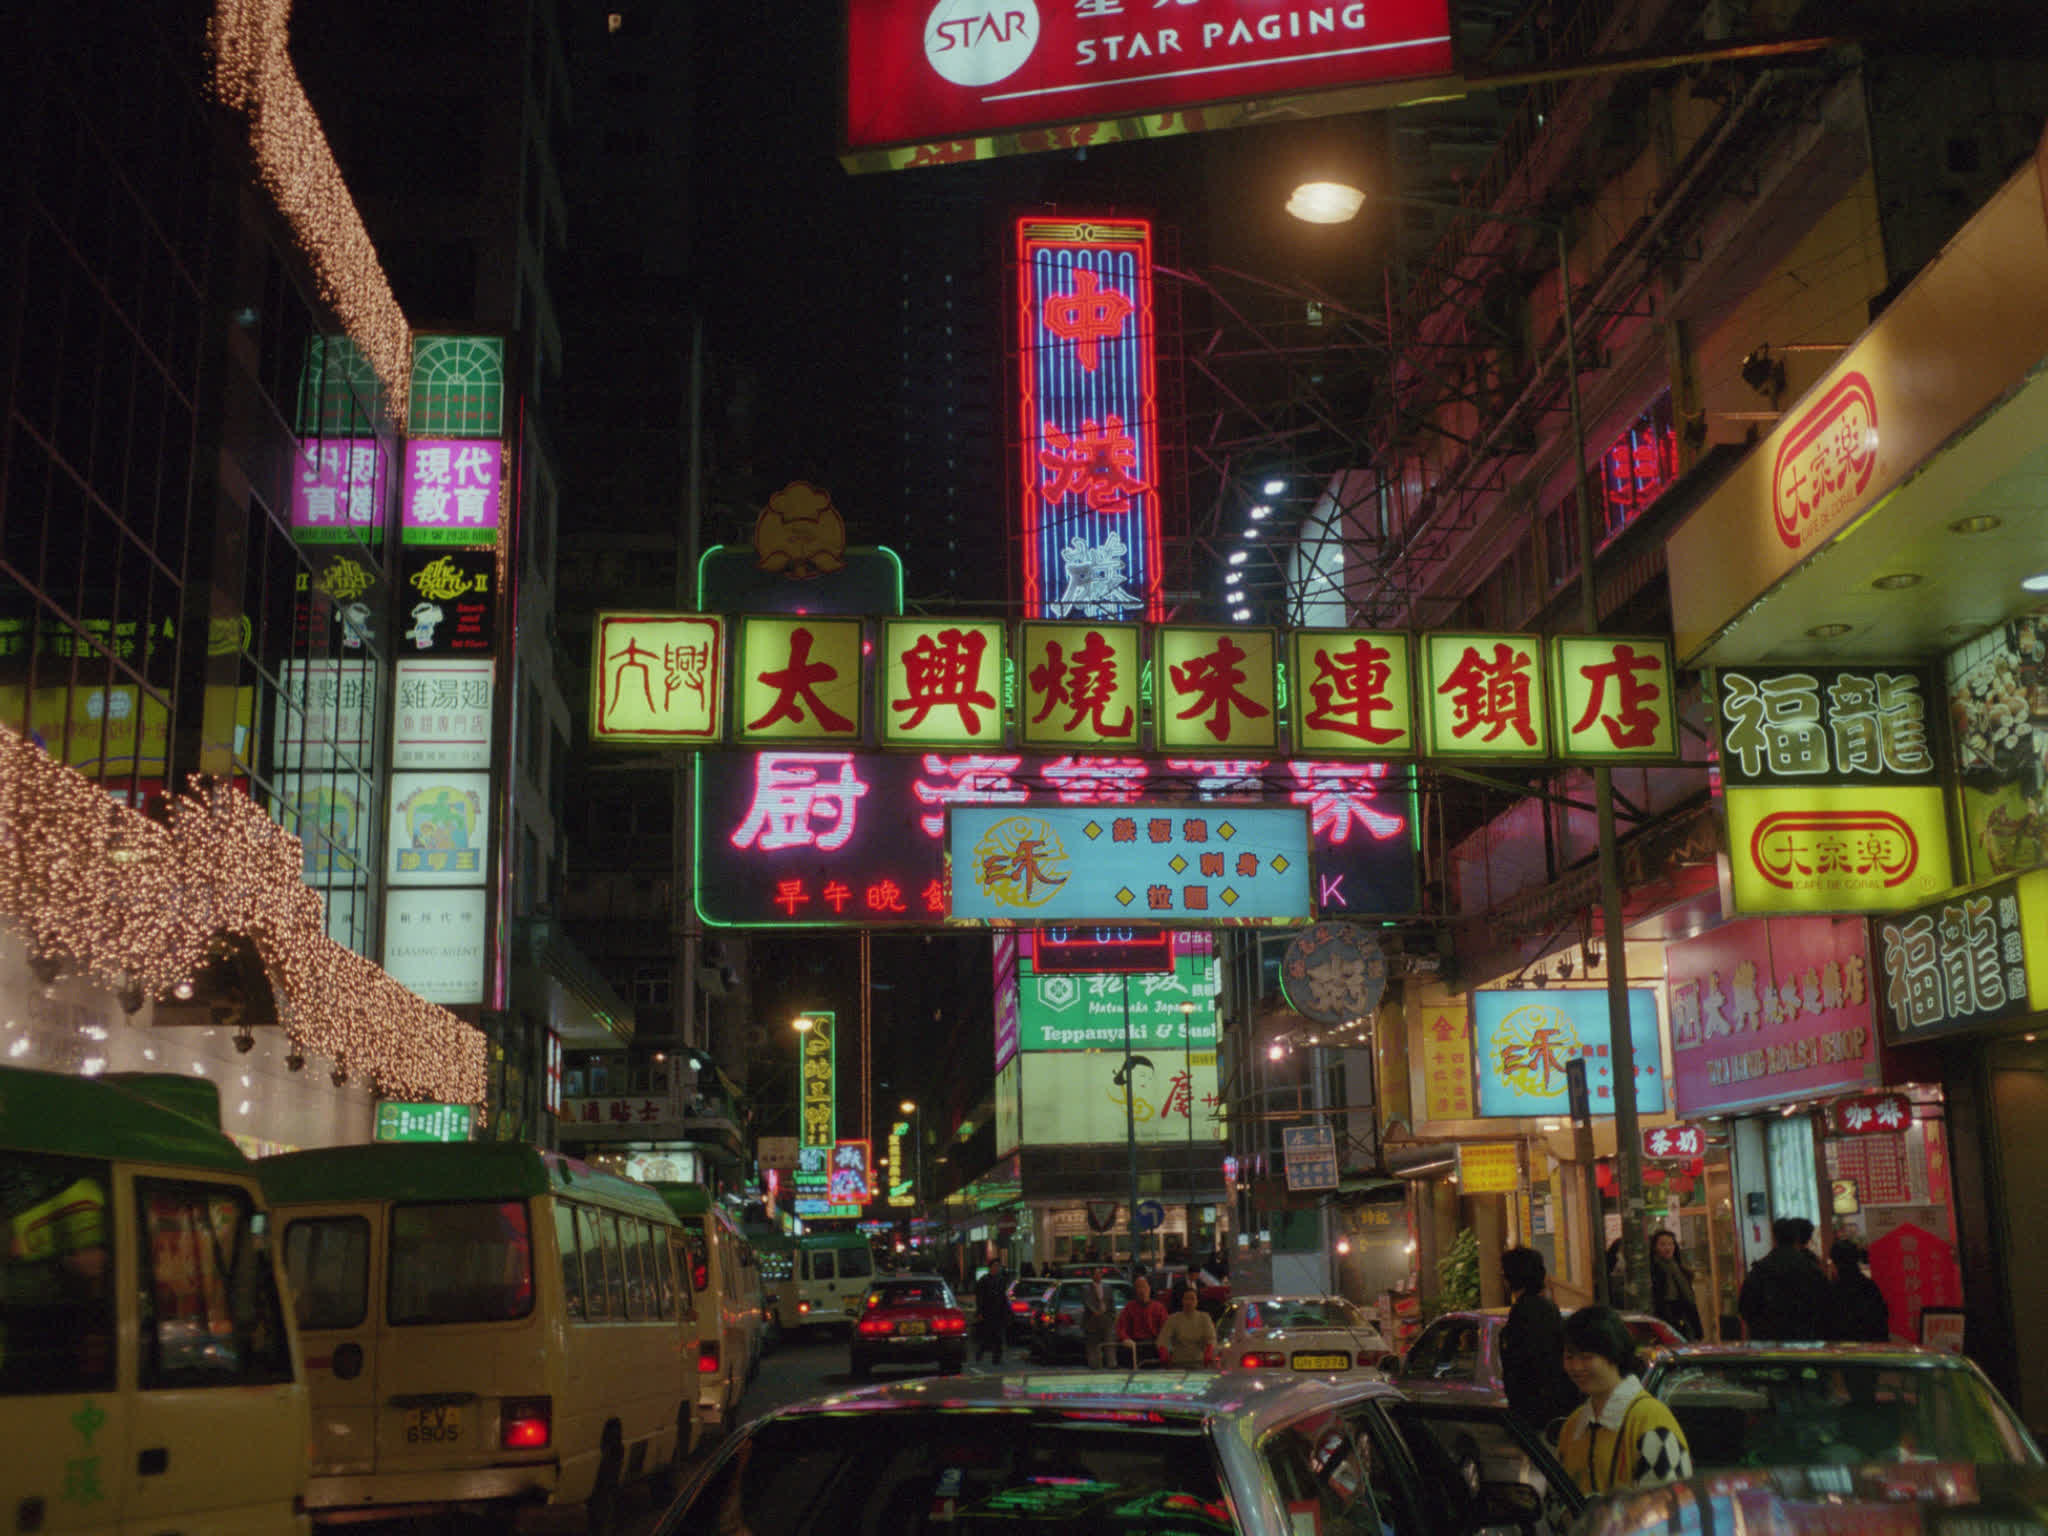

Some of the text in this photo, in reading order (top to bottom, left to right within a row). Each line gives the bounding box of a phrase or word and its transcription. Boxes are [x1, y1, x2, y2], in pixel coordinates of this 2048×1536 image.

[934, 14, 1028, 53] STAR
[1075, 29, 1182, 66] STAR
[1203, 3, 1366, 48] PAGING
[413, 447, 492, 485] 現代
[411, 486, 491, 523] 教育
[401, 679, 489, 710] 雞湯翅
[747, 627, 1662, 750] 太興燒味連鎖店
[1723, 673, 1934, 776] 福龍
[1882, 895, 2006, 1032] 福龍
[1040, 1024, 1147, 1044] Teppanyaki
[1155, 1024, 1173, 1039] &
